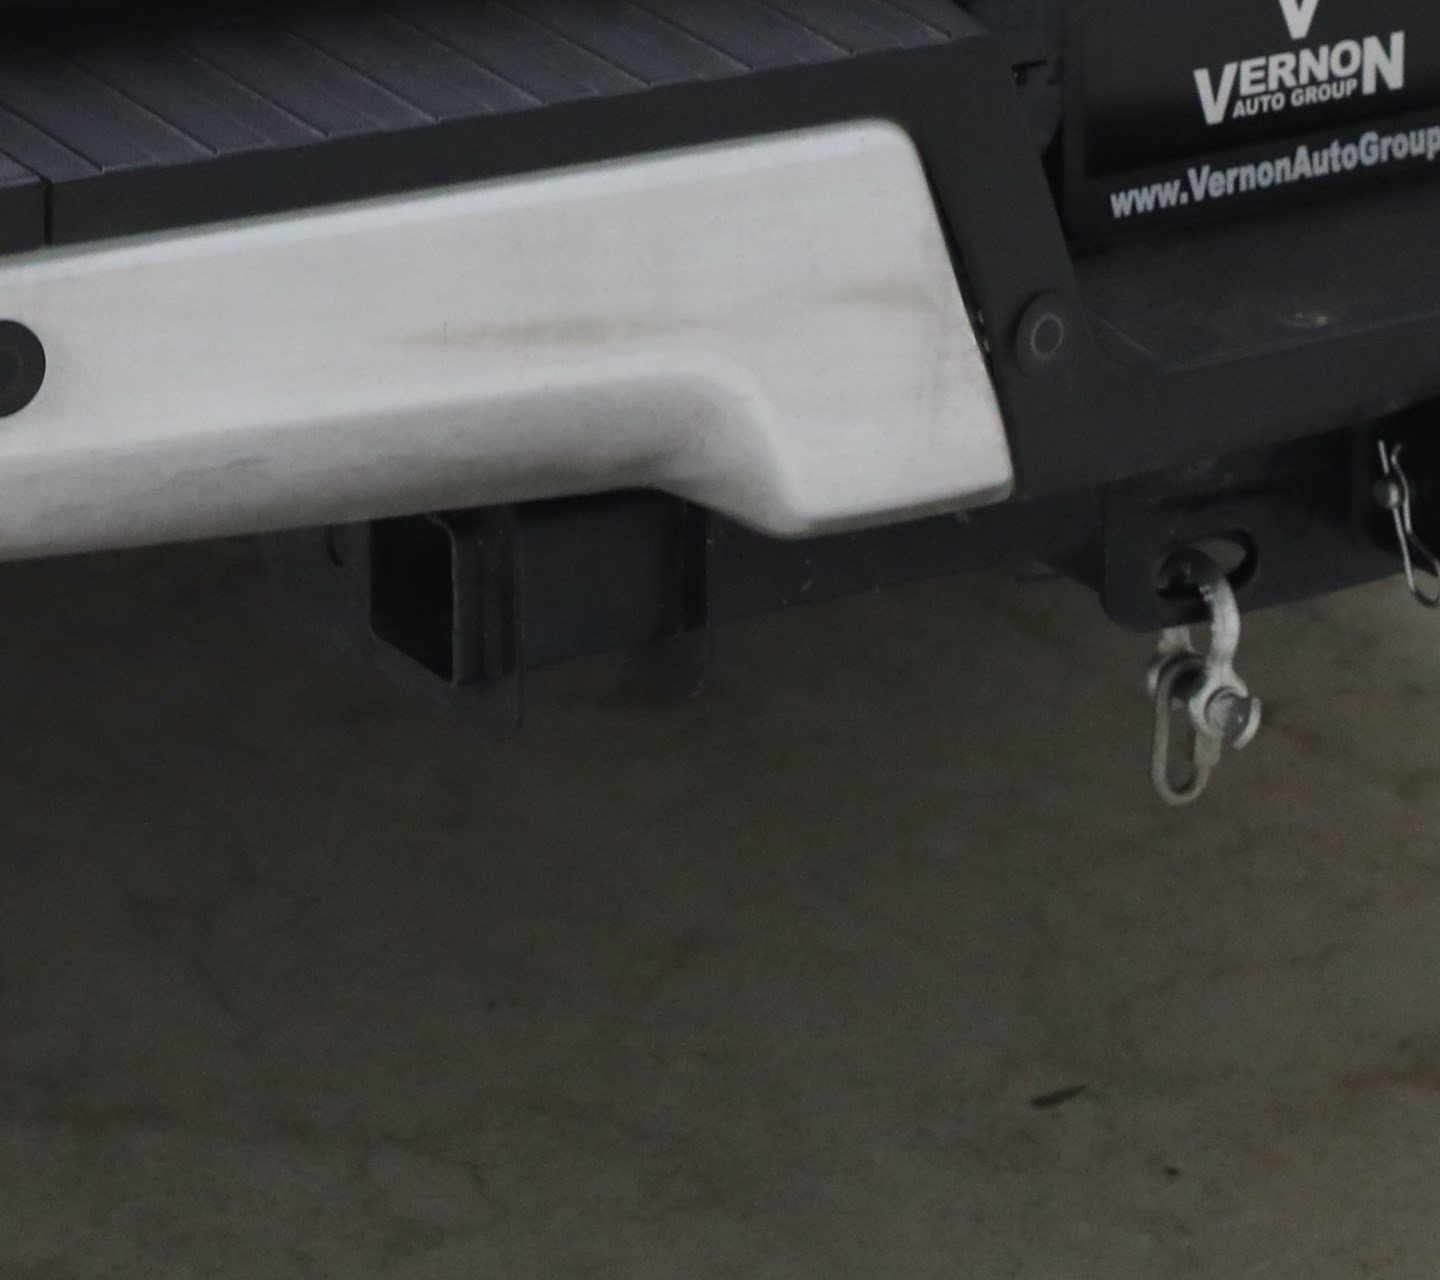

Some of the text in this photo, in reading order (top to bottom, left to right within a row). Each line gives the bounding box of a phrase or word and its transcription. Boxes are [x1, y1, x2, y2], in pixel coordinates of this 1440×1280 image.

[1193, 31, 1406, 125] VERNON
[1231, 78, 1359, 119] AUTO GROUP
